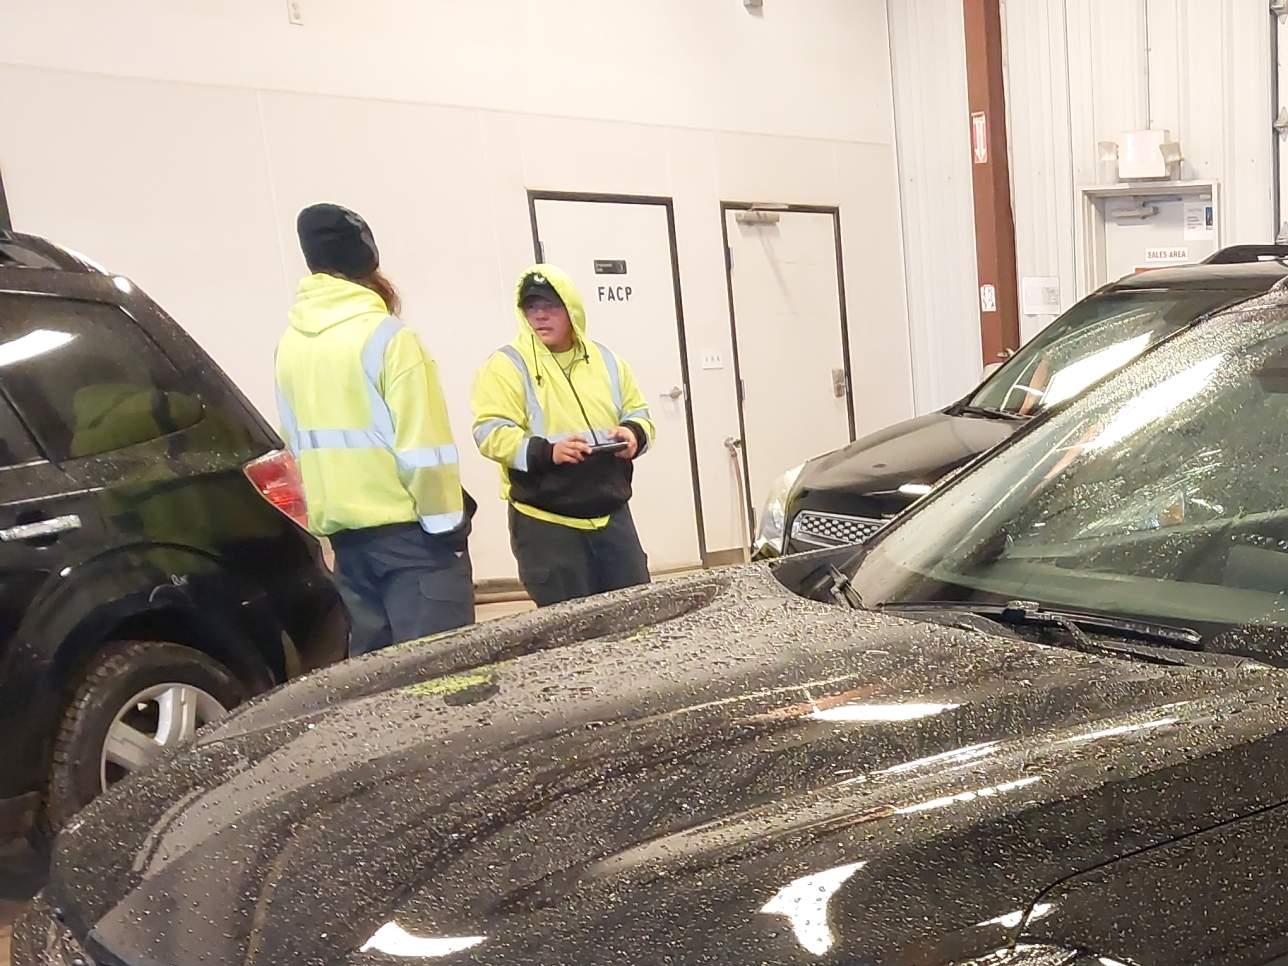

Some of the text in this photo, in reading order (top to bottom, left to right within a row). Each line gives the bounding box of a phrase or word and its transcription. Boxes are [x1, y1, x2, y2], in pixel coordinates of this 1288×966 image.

[1147, 250, 1187, 259] SALES AREA
[597, 286, 632, 302] FACP
